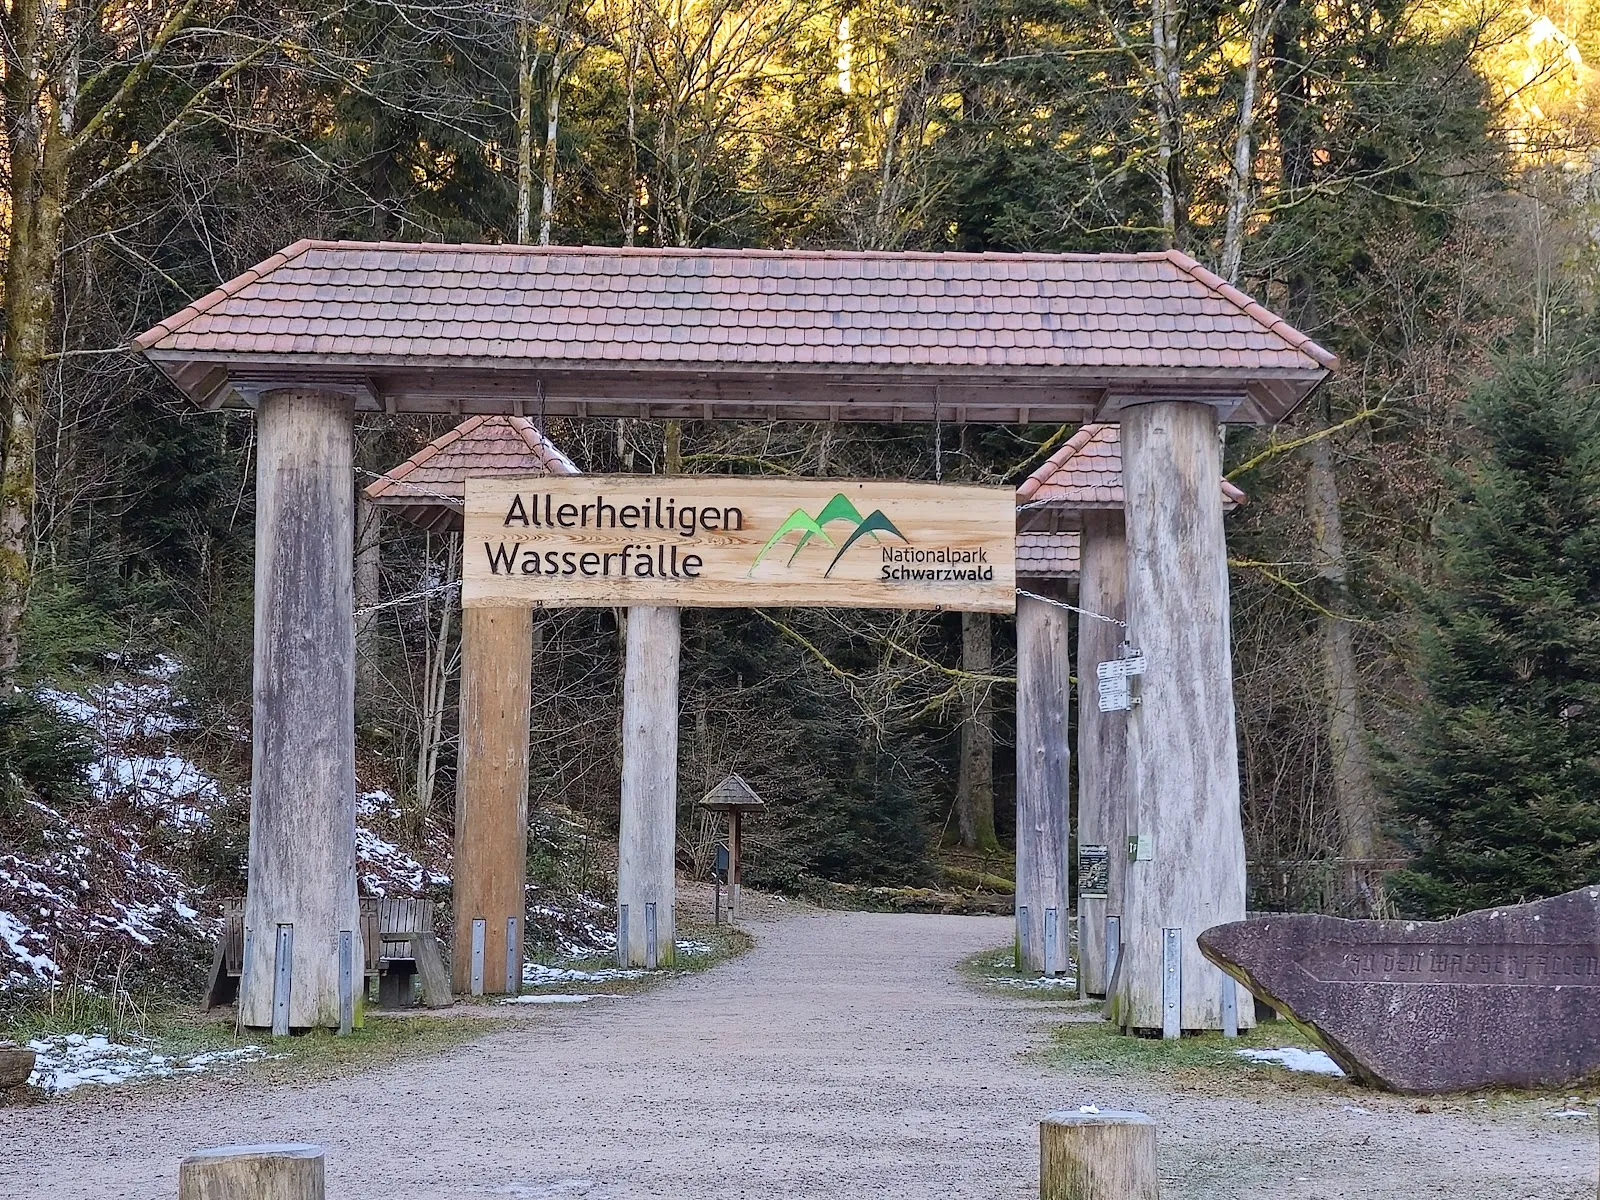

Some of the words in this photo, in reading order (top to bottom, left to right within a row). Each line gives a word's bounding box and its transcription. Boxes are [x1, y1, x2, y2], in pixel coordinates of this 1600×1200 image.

[505, 493, 743, 537] Allerheiligen
[484, 541, 703, 578] Wasserfälle
[882, 546, 988, 566] Nationalpark
[881, 564, 994, 581] Schwarzwald
